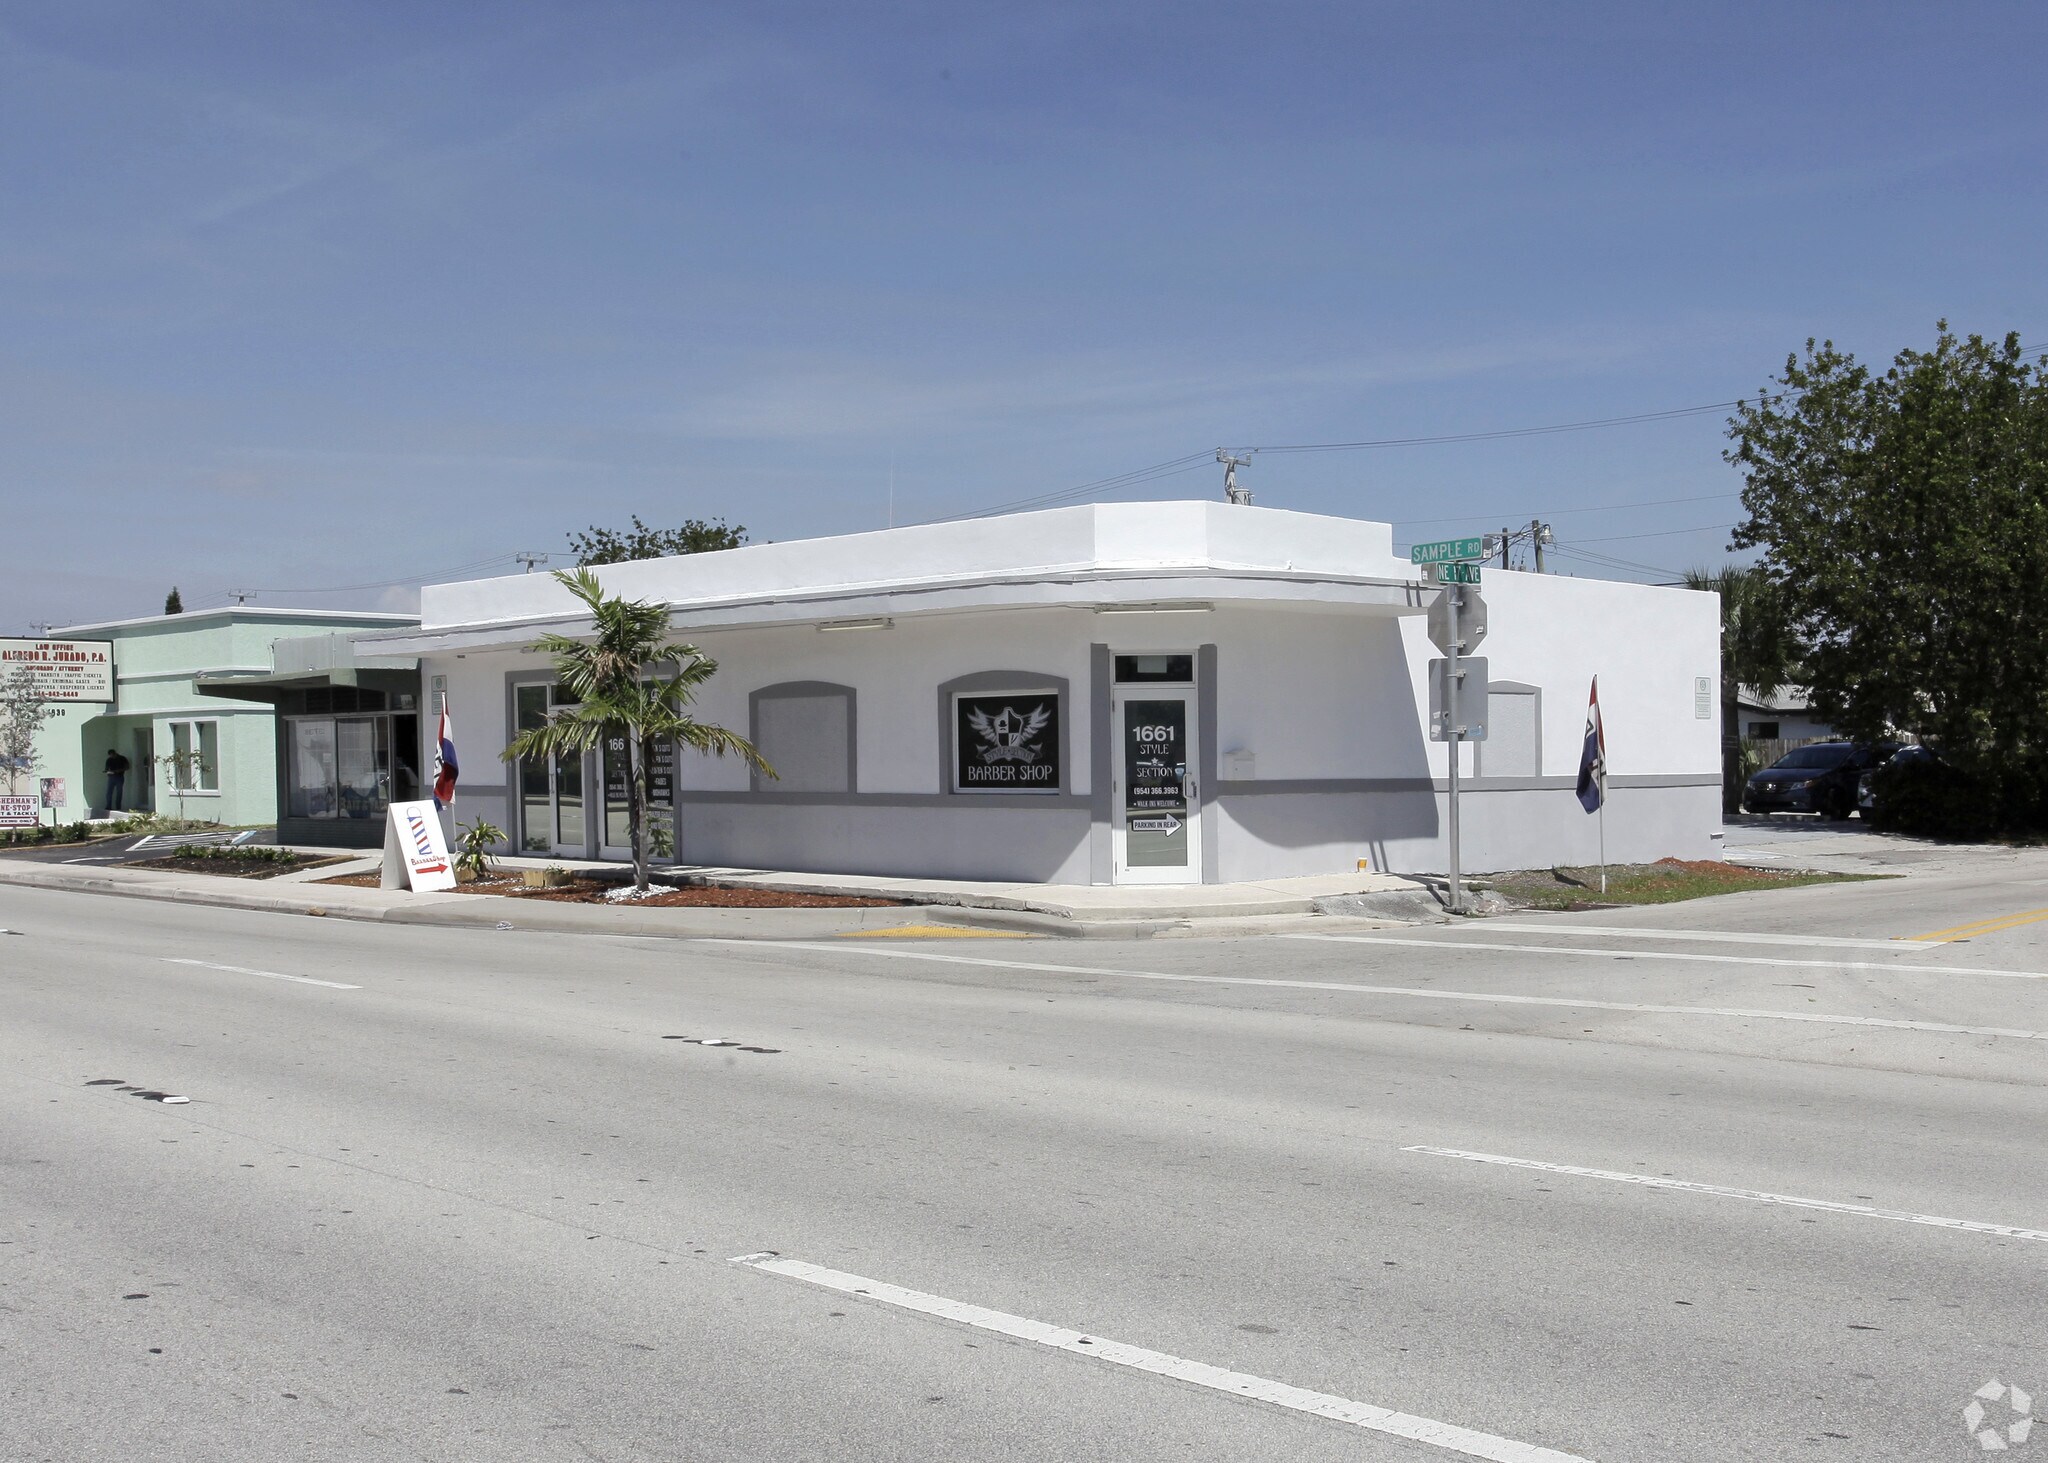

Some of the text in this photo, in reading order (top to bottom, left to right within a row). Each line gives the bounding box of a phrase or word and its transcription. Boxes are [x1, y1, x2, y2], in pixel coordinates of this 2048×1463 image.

[1413, 542, 1480, 562] SAMPLE RD
[1438, 565, 1450, 580] NE
[1465, 566, 1480, 582] AVE
[2, 650, 107, 663] ALFREDO R. JURADO, P.A.
[1132, 726, 1175, 742] 1661
[1140, 744, 1169, 755] STYLE
[968, 766, 1053, 781] BARBER SHOP
[1136, 767, 1173, 778] SECTION
[1133, 787, 1150, 795] (954)
[1134, 821, 1177, 829] PARKING IN REAR
